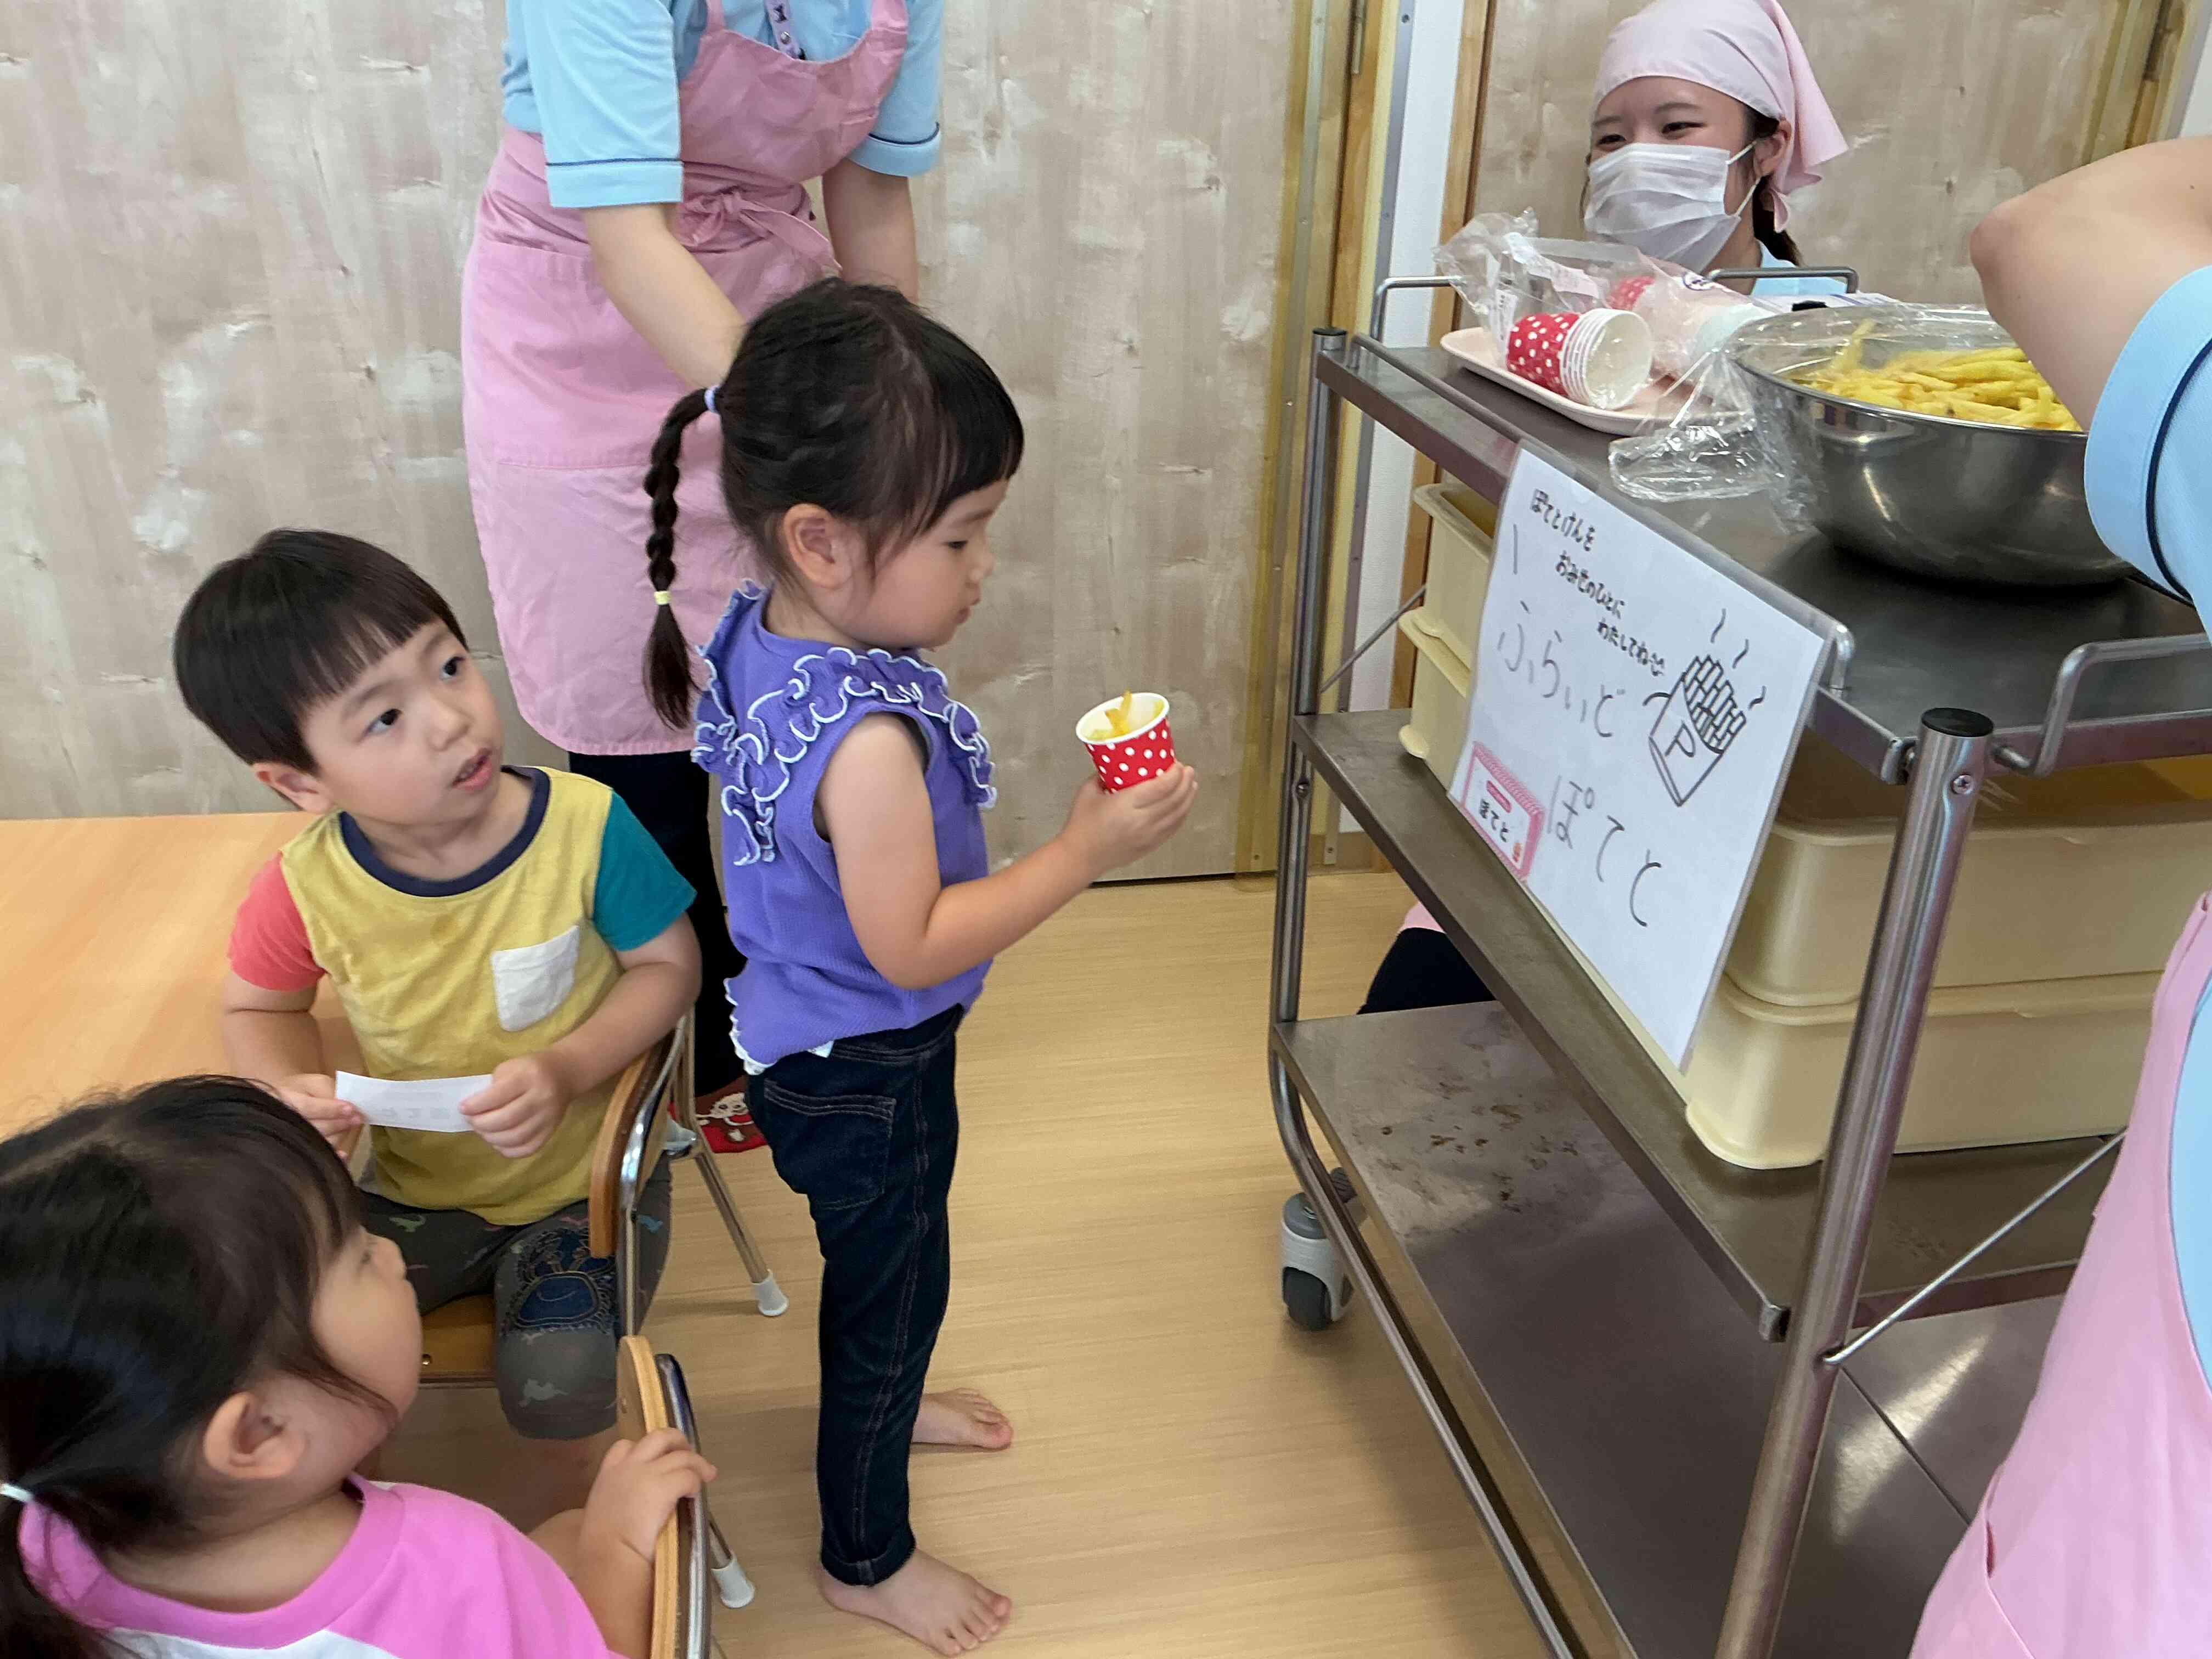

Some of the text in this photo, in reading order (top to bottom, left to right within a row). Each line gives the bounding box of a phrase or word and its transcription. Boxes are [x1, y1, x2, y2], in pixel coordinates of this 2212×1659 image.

[1555, 550, 1625, 619] おみせのひとに
[1664, 720, 1696, 758] P
[1546, 775, 1662, 927] ぽてと
